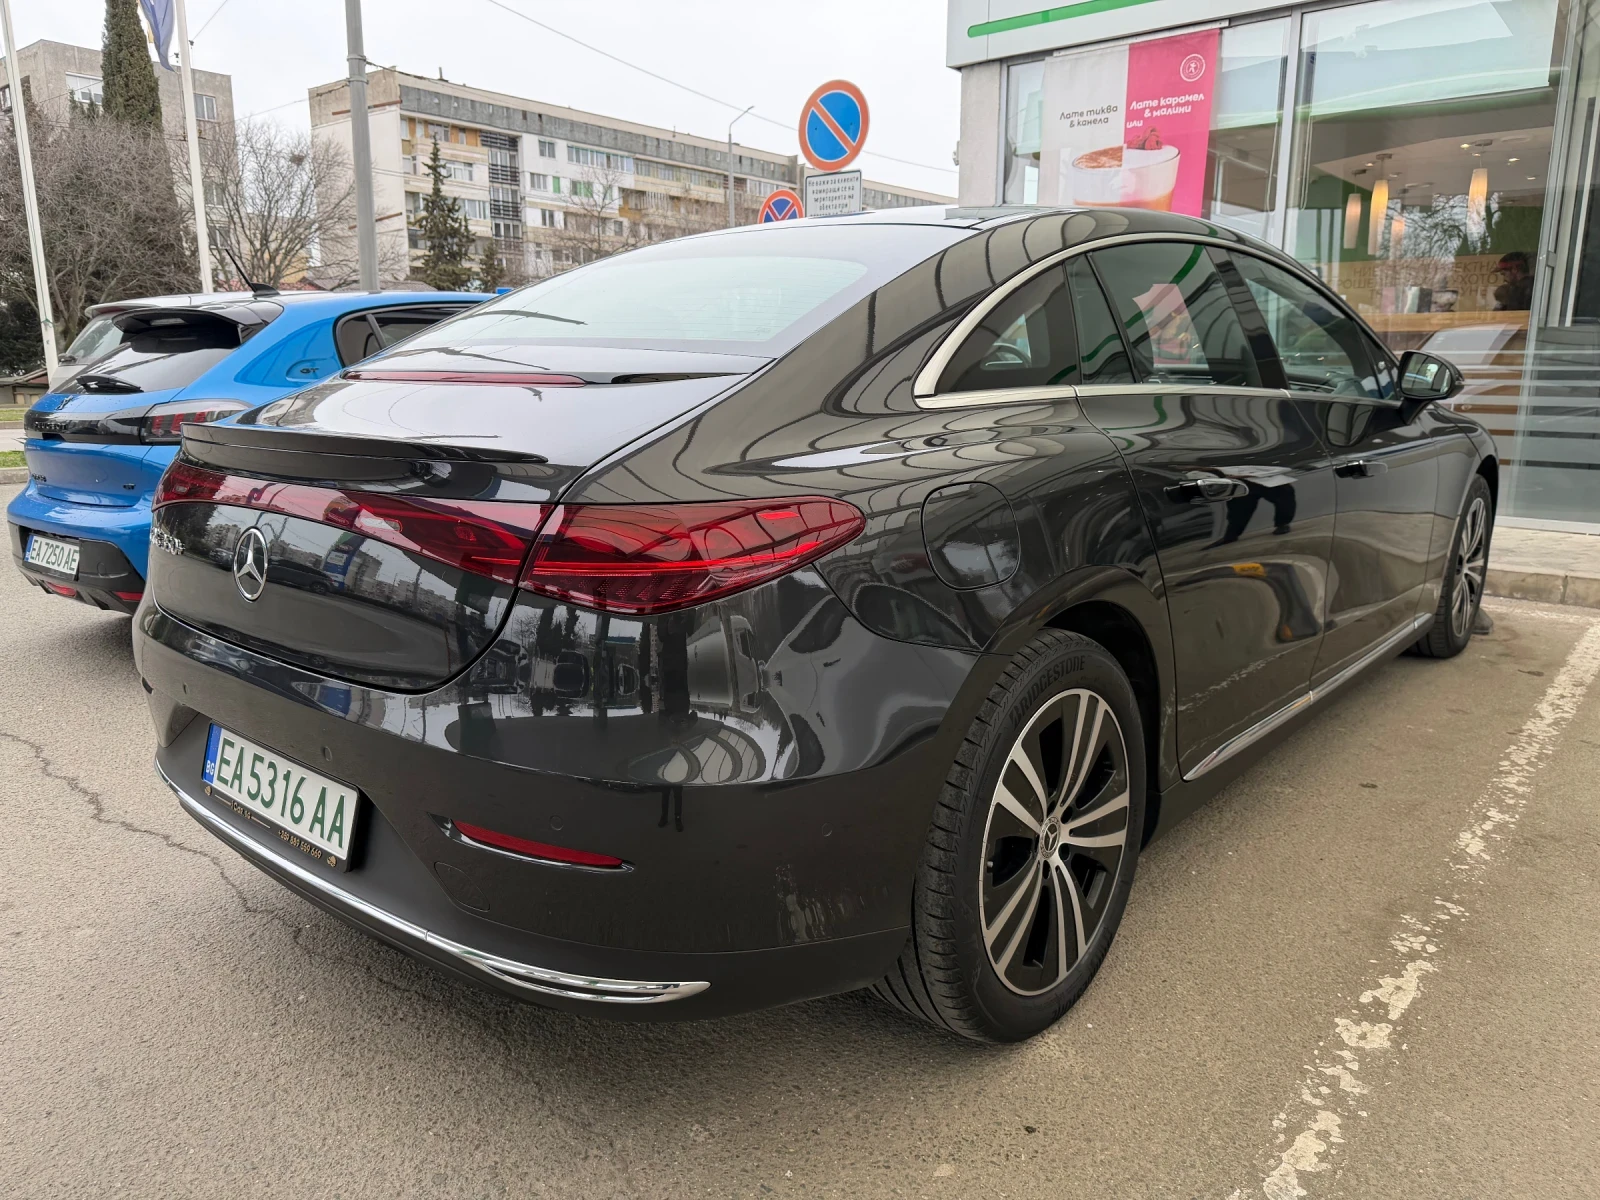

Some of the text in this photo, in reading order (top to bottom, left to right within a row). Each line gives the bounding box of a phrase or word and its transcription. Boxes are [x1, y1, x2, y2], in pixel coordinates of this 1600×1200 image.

[1130, 93, 1205, 111] Лате карамел
[1059, 105, 1118, 121] Лате тиква
[1144, 104, 1192, 118] & малини
[1069, 116, 1109, 128] & канела
[1126, 120, 1144, 129] или
[30, 539, 79, 572] EA 7250 AE
[1008, 655, 1086, 731] BRIDGESTONE
[205, 760, 215, 776] BG
[216, 737, 346, 849] EA 5316 AA
